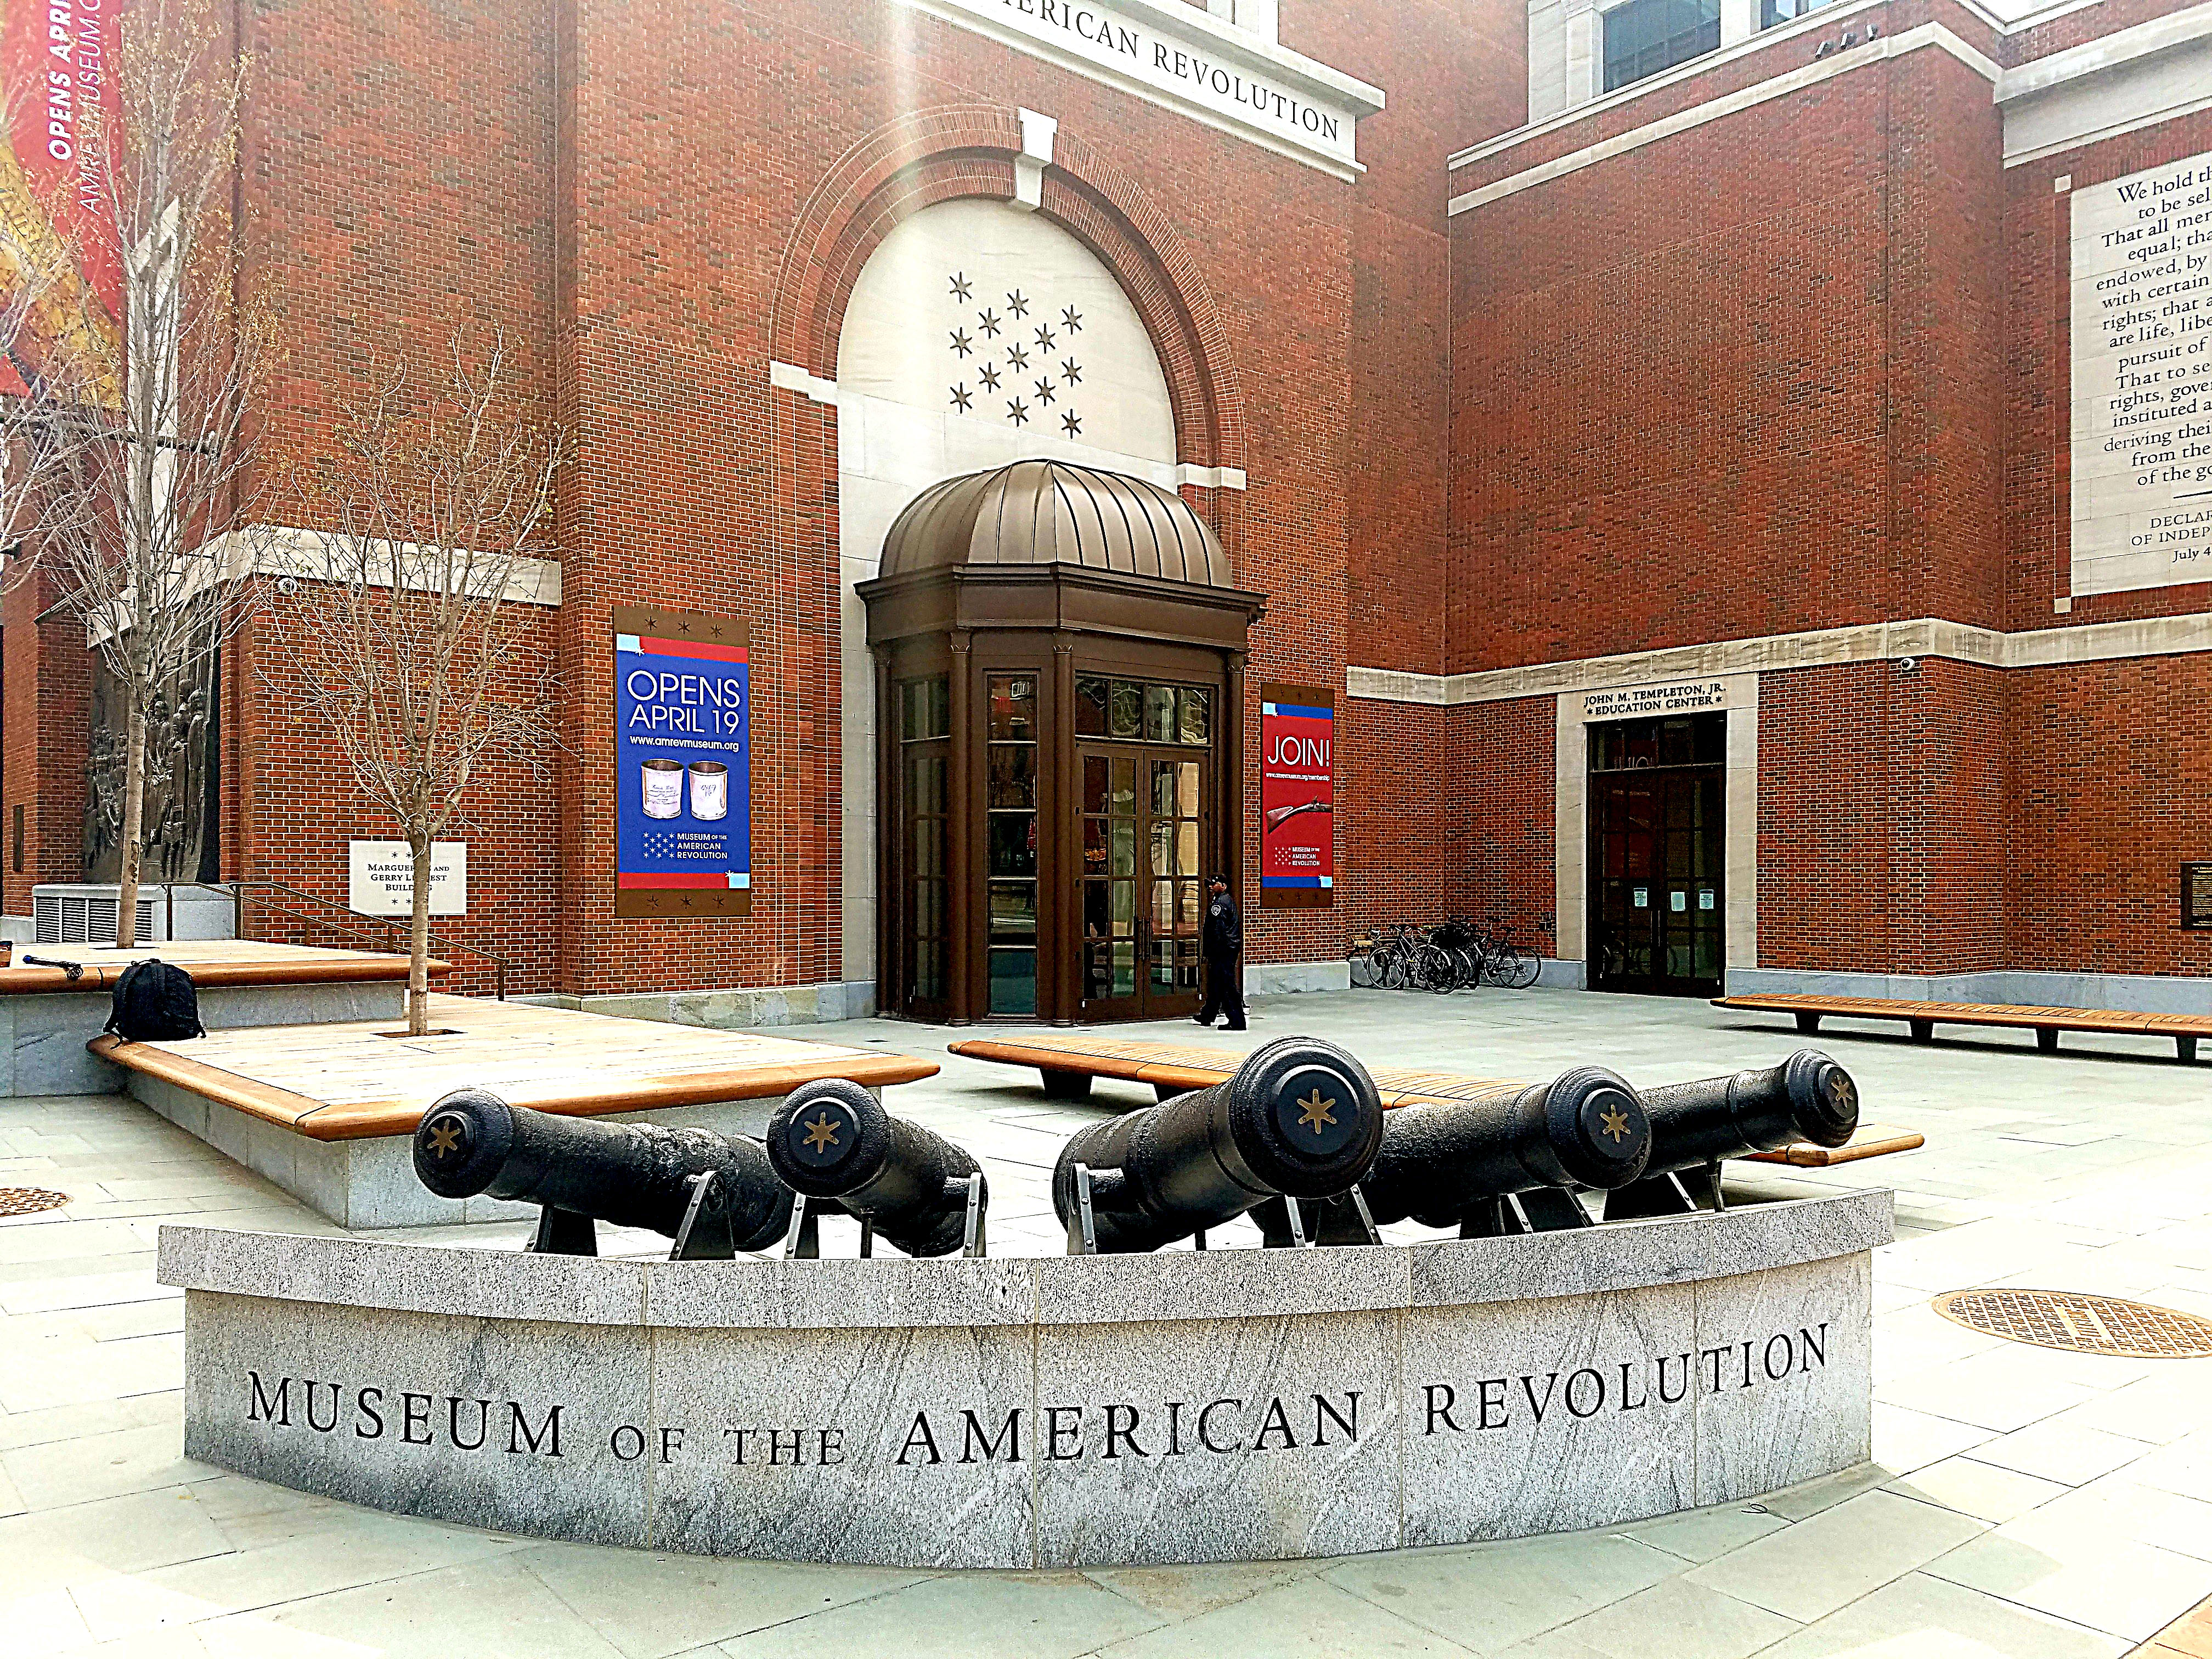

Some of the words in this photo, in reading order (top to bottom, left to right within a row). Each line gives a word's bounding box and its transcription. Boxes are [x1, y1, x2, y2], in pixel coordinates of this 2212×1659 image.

[1153, 42, 1339, 142] REVOLUTION
[48, 71, 72, 160] OPENS
[2117, 182, 2147, 203] We
[2153, 171, 2193, 196] hold
[2138, 207, 2155, 219] to
[2162, 199, 2181, 213] be
[2187, 187, 2211, 206] sel
[2101, 229, 2143, 247] That
[2148, 217, 2169, 236] all
[2128, 236, 2181, 262] equal;
[2096, 258, 2182, 291] endowed,
[2187, 255, 2208, 272] by
[2102, 289, 2141, 308] with
[2148, 274, 2209, 298] certain
[2103, 310, 2157, 332] rights;
[2163, 300, 2199, 317] that
[2109, 334, 2134, 348] are
[2139, 323, 2175, 342] life,
[2118, 344, 2182, 374] pursuit
[2188, 336, 2209, 354] of
[2115, 372, 2160, 390] That
[2167, 368, 2186, 379] to
[2192, 362, 2210, 375] se
[2109, 390, 2164, 413] rights,
[2170, 381, 2212, 403] gove
[2113, 398, 2197, 428] instituted
[2104, 431, 2172, 452] deriving
[2178, 420, 2211, 439] thei
[2132, 451, 2176, 467] from
[2182, 442, 2211, 459] the
[2137, 469, 2159, 486] of
[2163, 466, 2192, 482] the
[2131, 534, 2152, 546] OF
[2159, 526, 2211, 543] INDEP
[2172, 548, 2199, 563] July
[627, 670, 740, 708] OPENS
[1584, 693, 1613, 708] JOHN
[1617, 692, 1630, 702] M.
[1632, 684, 1706, 701] TEMPLETON,
[1708, 683, 1727, 695] JR.
[629, 704, 706, 733] APRIL
[712, 709, 739, 735] 19
[1595, 701, 1662, 715] EDUCATION
[1665, 695, 1714, 709] CENTER
[629, 736, 739, 753] www.amrevmuseum.org
[1267, 735, 1330, 767] JOIN!
[677, 833, 710, 841] MUSEUM
[246, 1370, 565, 1458] MUSEUM
[610, 1425, 685, 1464] OF
[724, 1427, 845, 1466] THE
[894, 1391, 1364, 1466] AMERICAN
[1421, 1323, 1829, 1436] REVOLUTION
